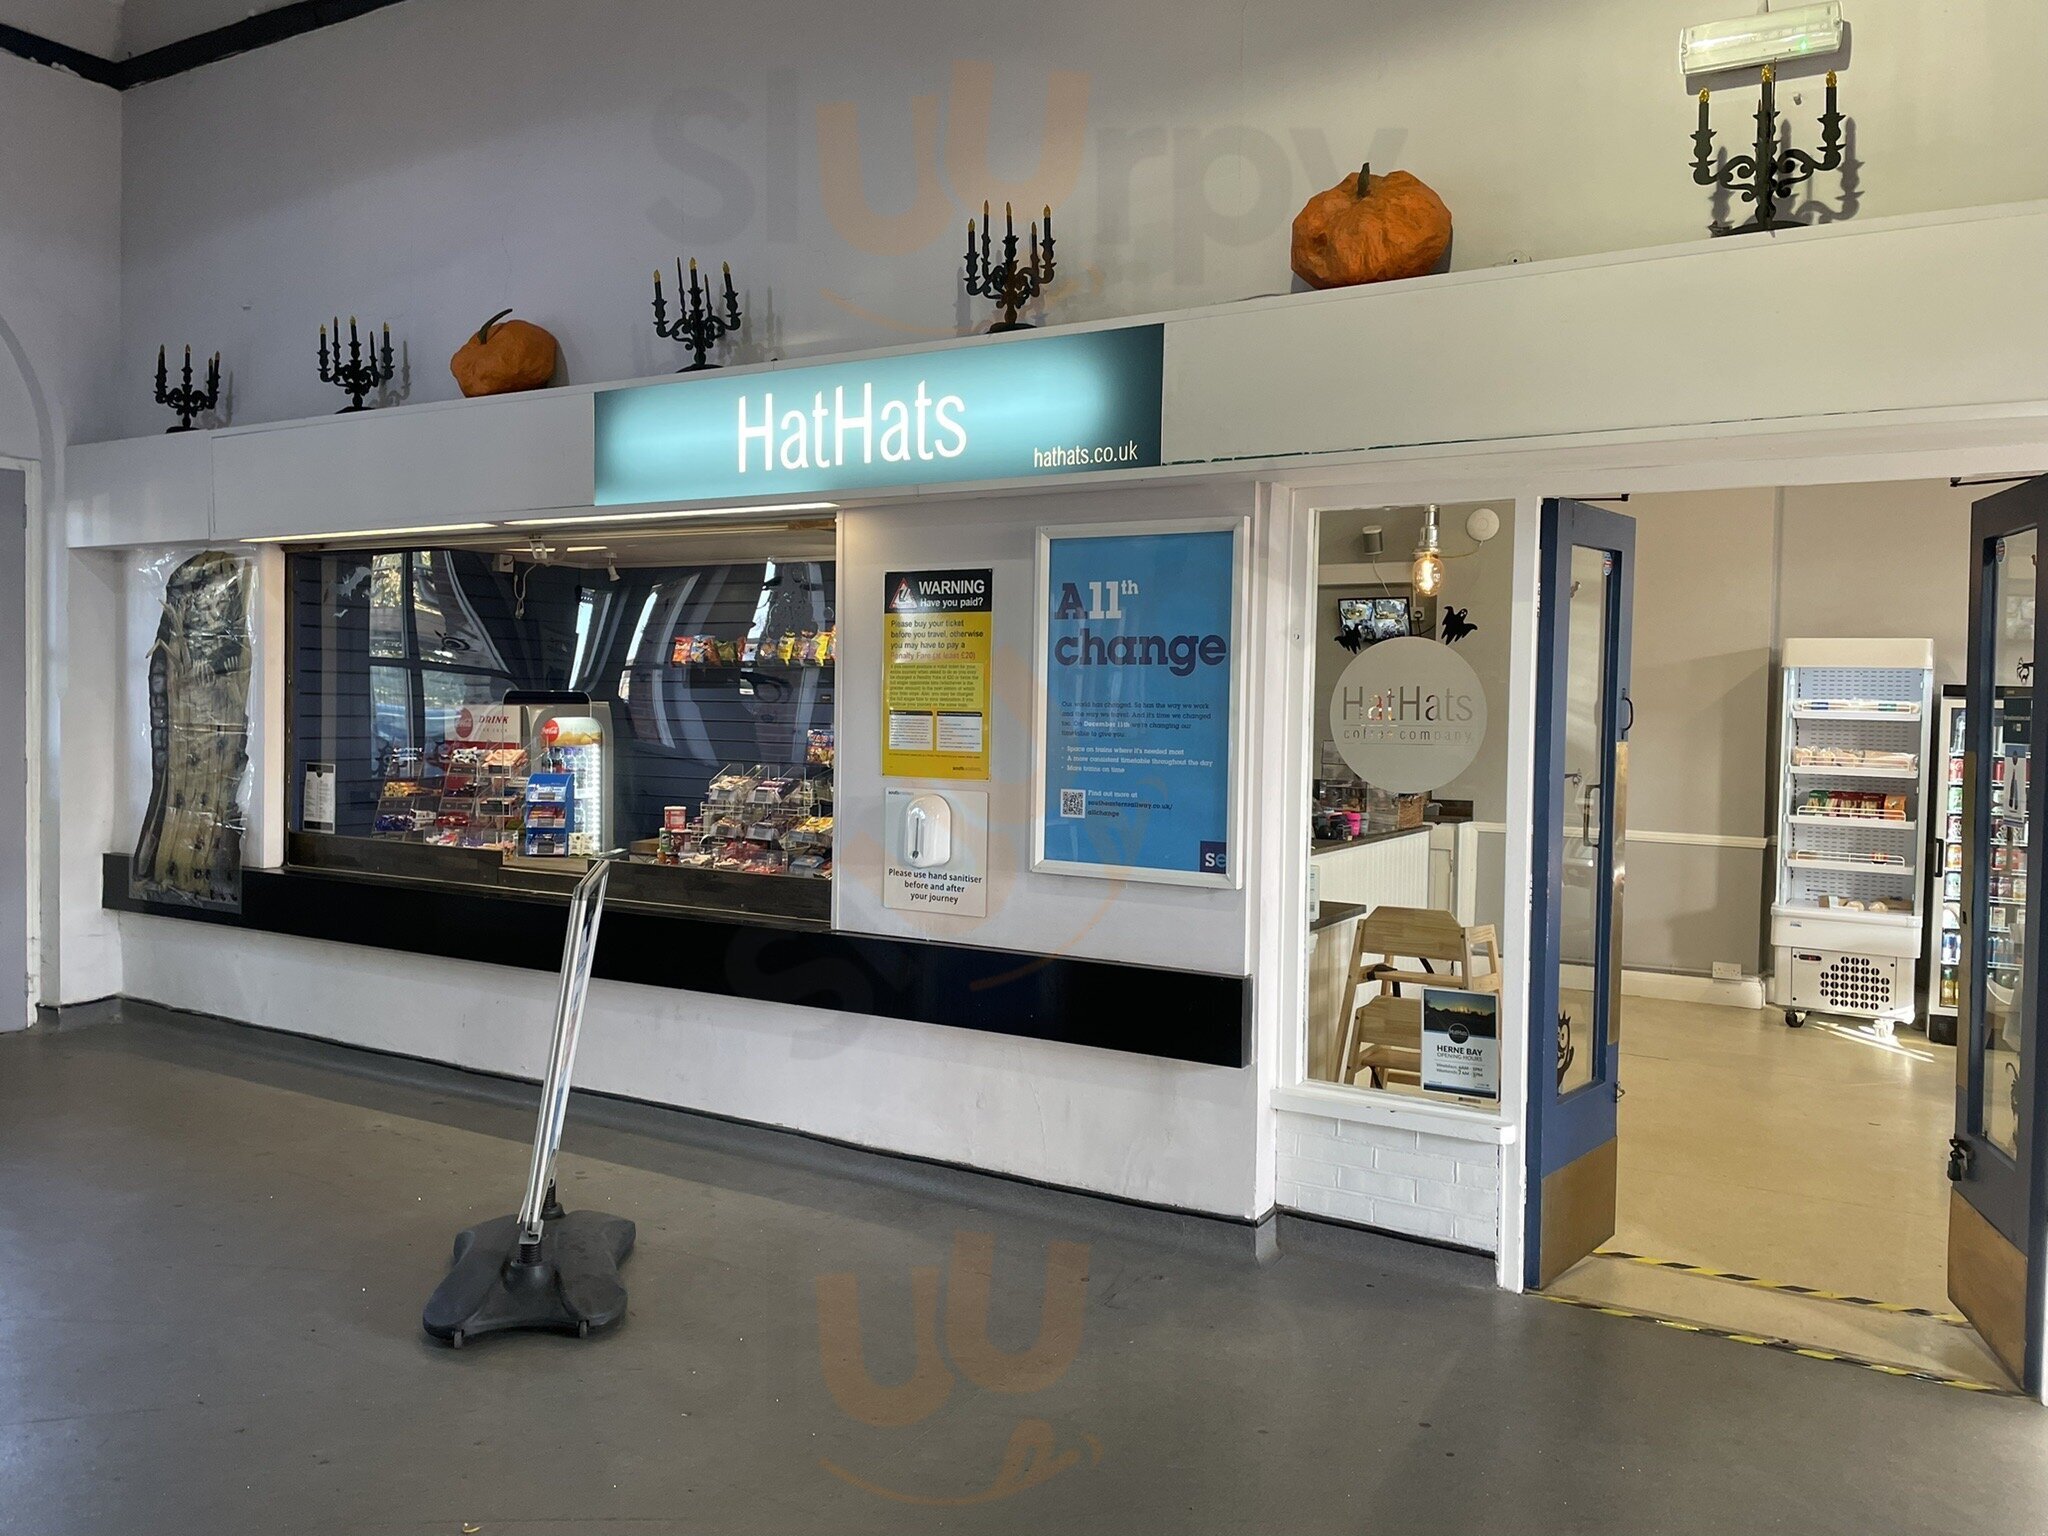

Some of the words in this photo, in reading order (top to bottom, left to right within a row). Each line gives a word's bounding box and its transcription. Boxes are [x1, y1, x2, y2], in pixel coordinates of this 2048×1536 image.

[737, 380, 967, 474] HatHats
[1033, 440, 1139, 469] hathats.co.uk
[918, 580, 985, 595] WARNING
[920, 598, 940, 608] Have
[942, 599, 958, 609] you
[960, 597, 984, 608] paid?
[914, 620, 927, 629] buy
[928, 621, 944, 629] your
[904, 642, 918, 650] may
[891, 652, 914, 660] Penalty
[1054, 628, 1227, 677] change
[1168, 703, 1181, 711] way
[1343, 686, 1473, 722] HatHats
[478, 715, 509, 724] DRINK
[1183, 712, 1211, 720] changed
[1149, 722, 1179, 730] changing
[1399, 729, 1472, 743] company
[1151, 758, 1187, 766] throughout
[1088, 810, 1119, 818] allchange
[888, 868, 912, 878] Please
[928, 872, 948, 881] hand
[949, 874, 982, 884] sanitiser
[904, 880, 928, 890] before
[930, 882, 944, 891] and
[946, 883, 965, 893] after
[910, 892, 928, 900] your
[928, 892, 959, 905] journey
[1436, 1045, 1464, 1054] HERNE
[1466, 1048, 1482, 1056] BAY
